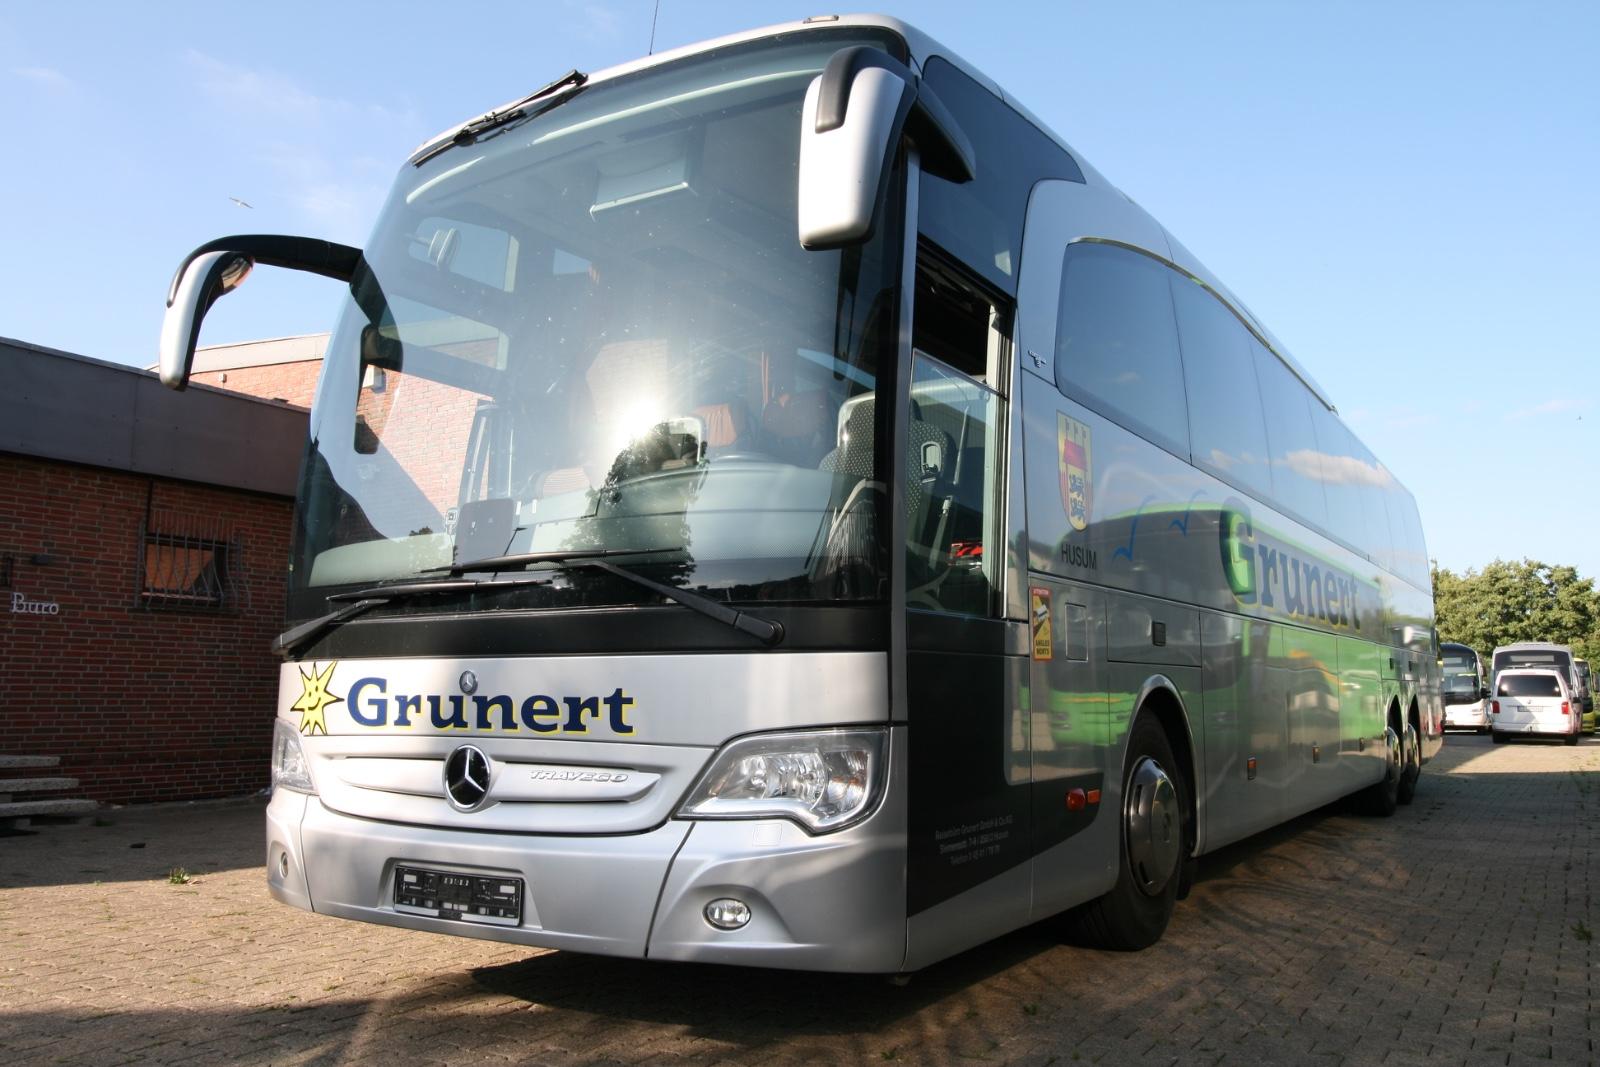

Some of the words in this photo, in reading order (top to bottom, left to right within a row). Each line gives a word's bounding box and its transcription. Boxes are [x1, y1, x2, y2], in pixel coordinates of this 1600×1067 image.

[1061, 544, 1097, 570] HUSUM
[1219, 496, 1361, 632] Grunert
[347, 677, 635, 735] Grunert
[530, 769, 629, 783] TRAVEGO
